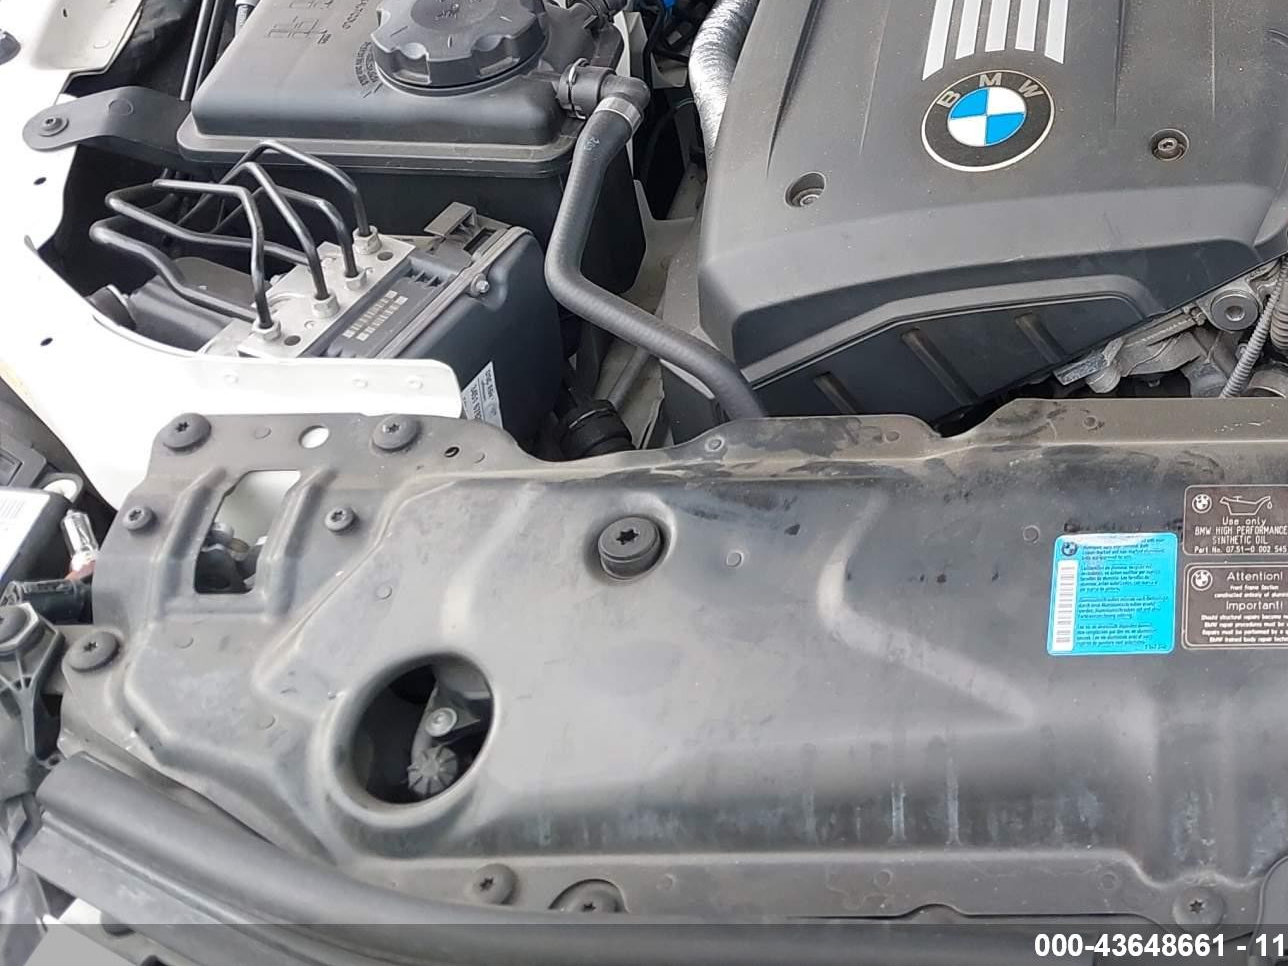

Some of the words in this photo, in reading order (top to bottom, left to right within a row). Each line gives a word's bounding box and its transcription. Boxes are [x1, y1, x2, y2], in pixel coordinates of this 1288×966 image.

[936, 73, 1044, 108] BMW
[1222, 517, 1239, 525] Use
[1246, 517, 1267, 527] only
[1195, 526, 1211, 535] BMW
[1216, 526, 1232, 534] HIGH
[1237, 526, 1288, 535] PERFORMANCE
[1213, 536, 1251, 545] SYNTHETIC
[1256, 536, 1268, 544] OIL
[1227, 572, 1283, 581] Attention!
[1226, 601, 1283, 612] Important!
